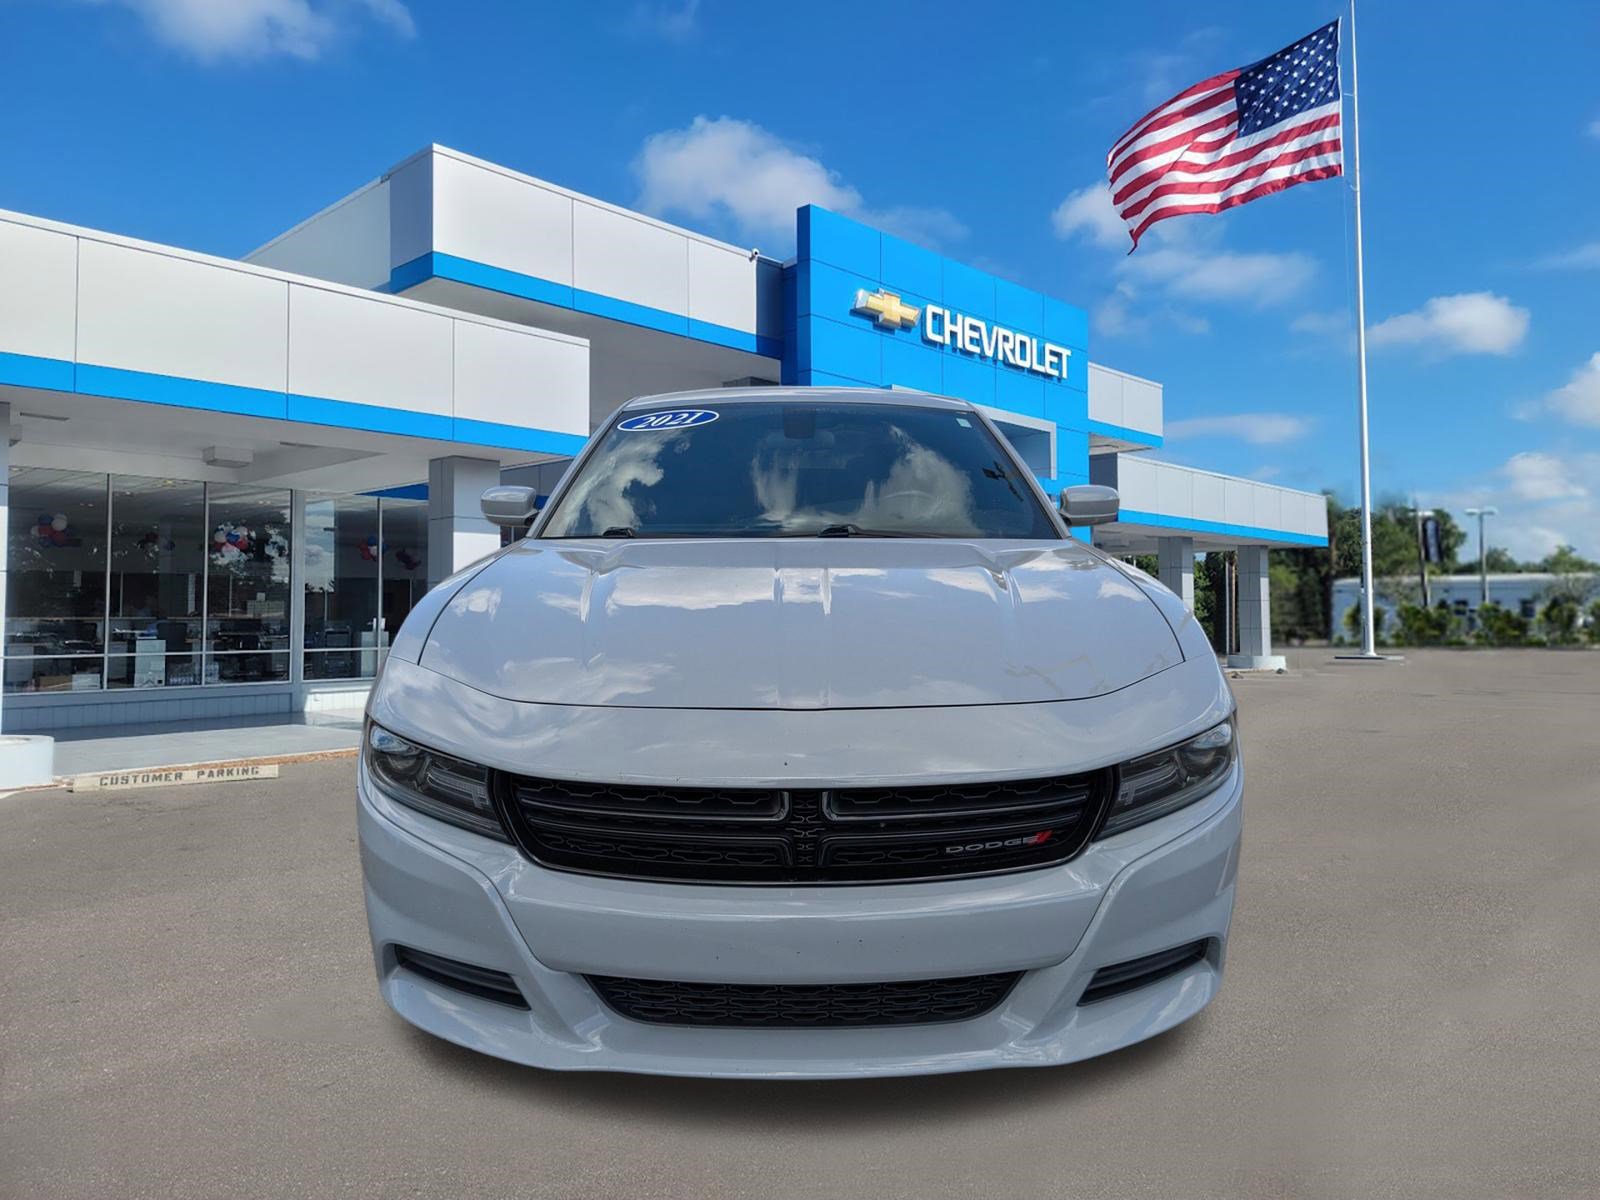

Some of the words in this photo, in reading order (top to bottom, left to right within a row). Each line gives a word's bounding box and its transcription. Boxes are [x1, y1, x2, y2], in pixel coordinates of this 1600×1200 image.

[925, 304, 1072, 379] CHEVROLET
[632, 412, 704, 429] 2021
[99, 771, 184, 787] CUSTOMER
[196, 766, 260, 779] PARKING
[945, 835, 1038, 854] DODGE
